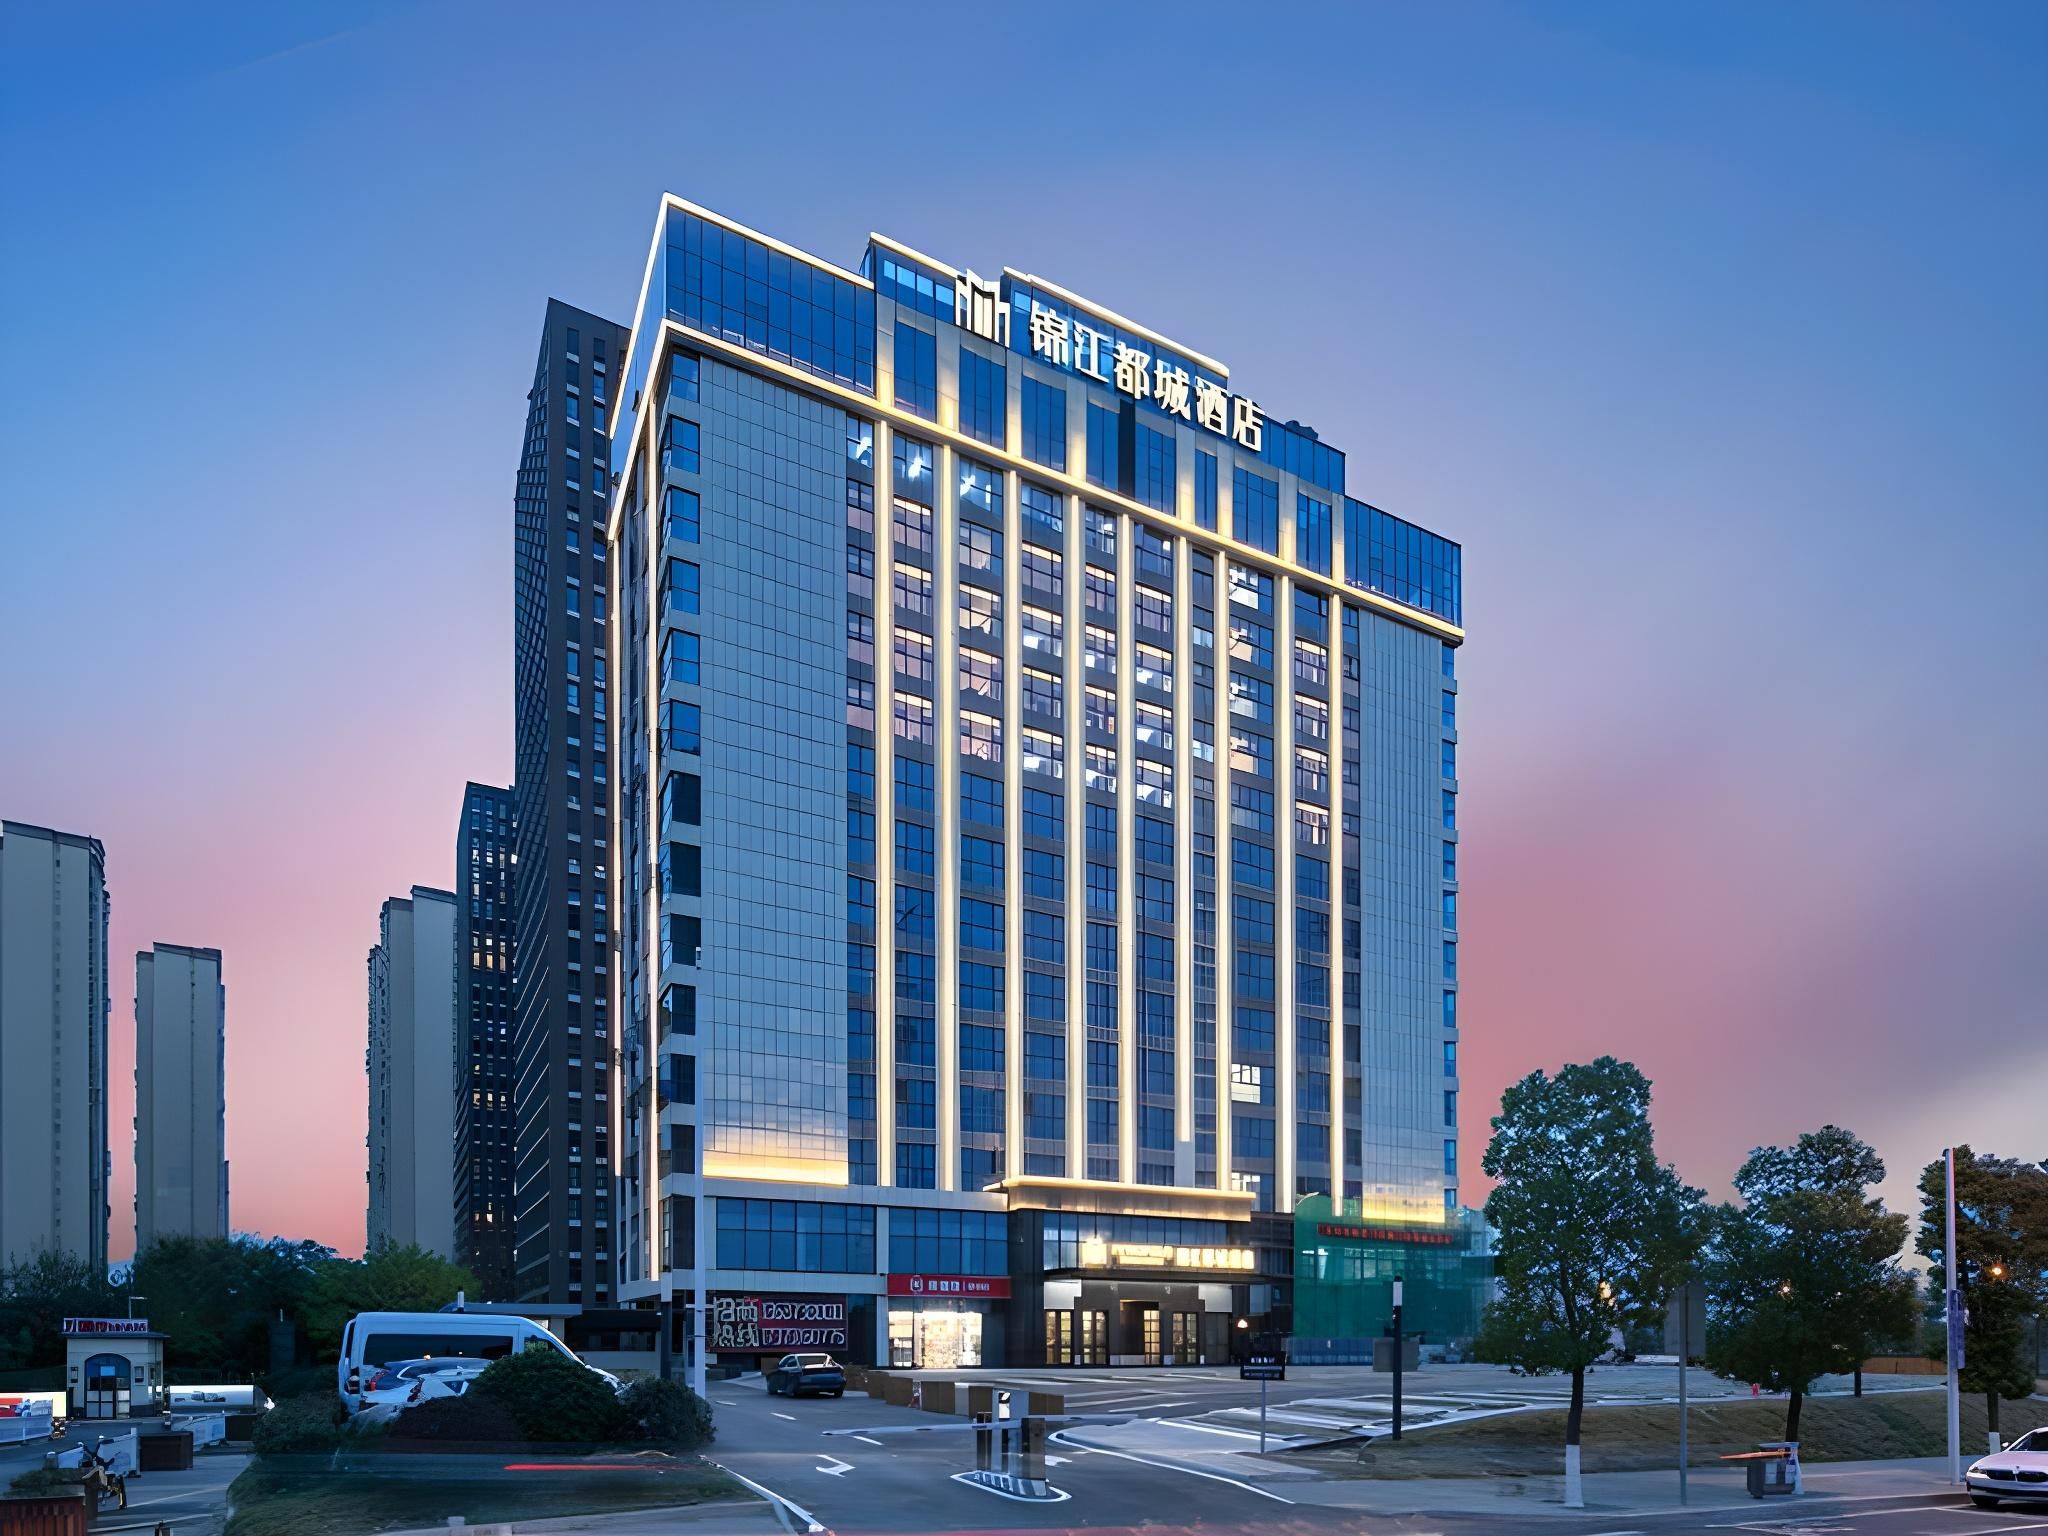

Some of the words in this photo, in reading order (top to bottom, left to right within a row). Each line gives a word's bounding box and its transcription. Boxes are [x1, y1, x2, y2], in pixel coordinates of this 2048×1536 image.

[1030, 300, 1265, 452] 锦江都城酒店
